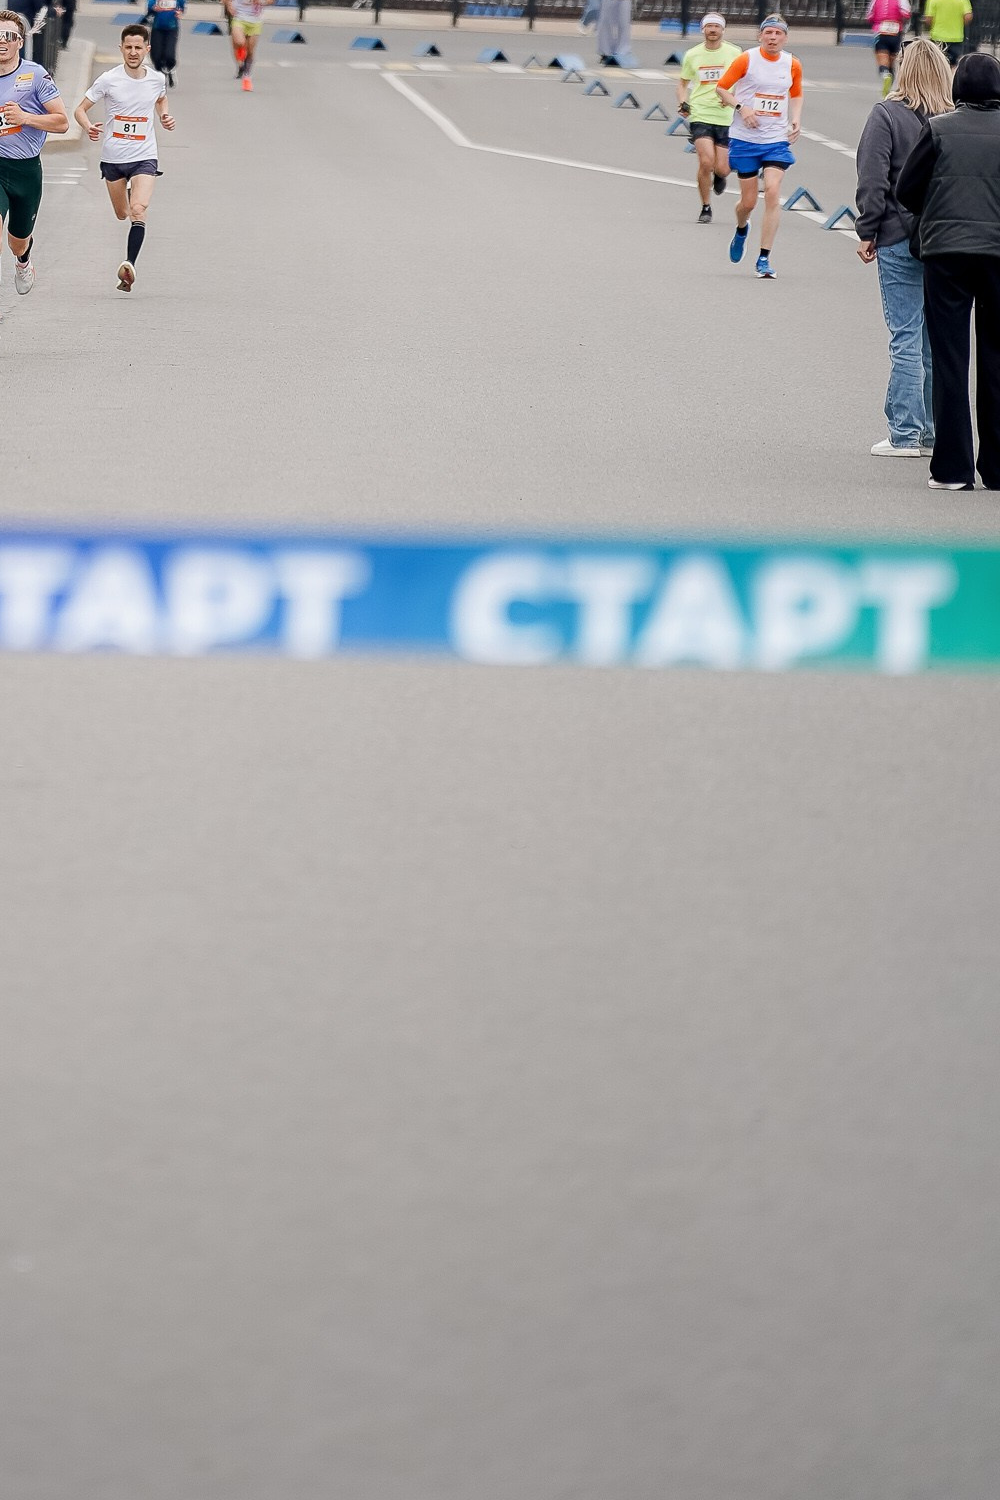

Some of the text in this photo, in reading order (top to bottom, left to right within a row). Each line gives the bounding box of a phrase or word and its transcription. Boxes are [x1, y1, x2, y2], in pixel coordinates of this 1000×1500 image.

[704, 71, 720, 79] 131
[761, 100, 779, 111] 112
[123, 123, 137, 133] 81
[451, 545, 956, 674] СТАРТ
